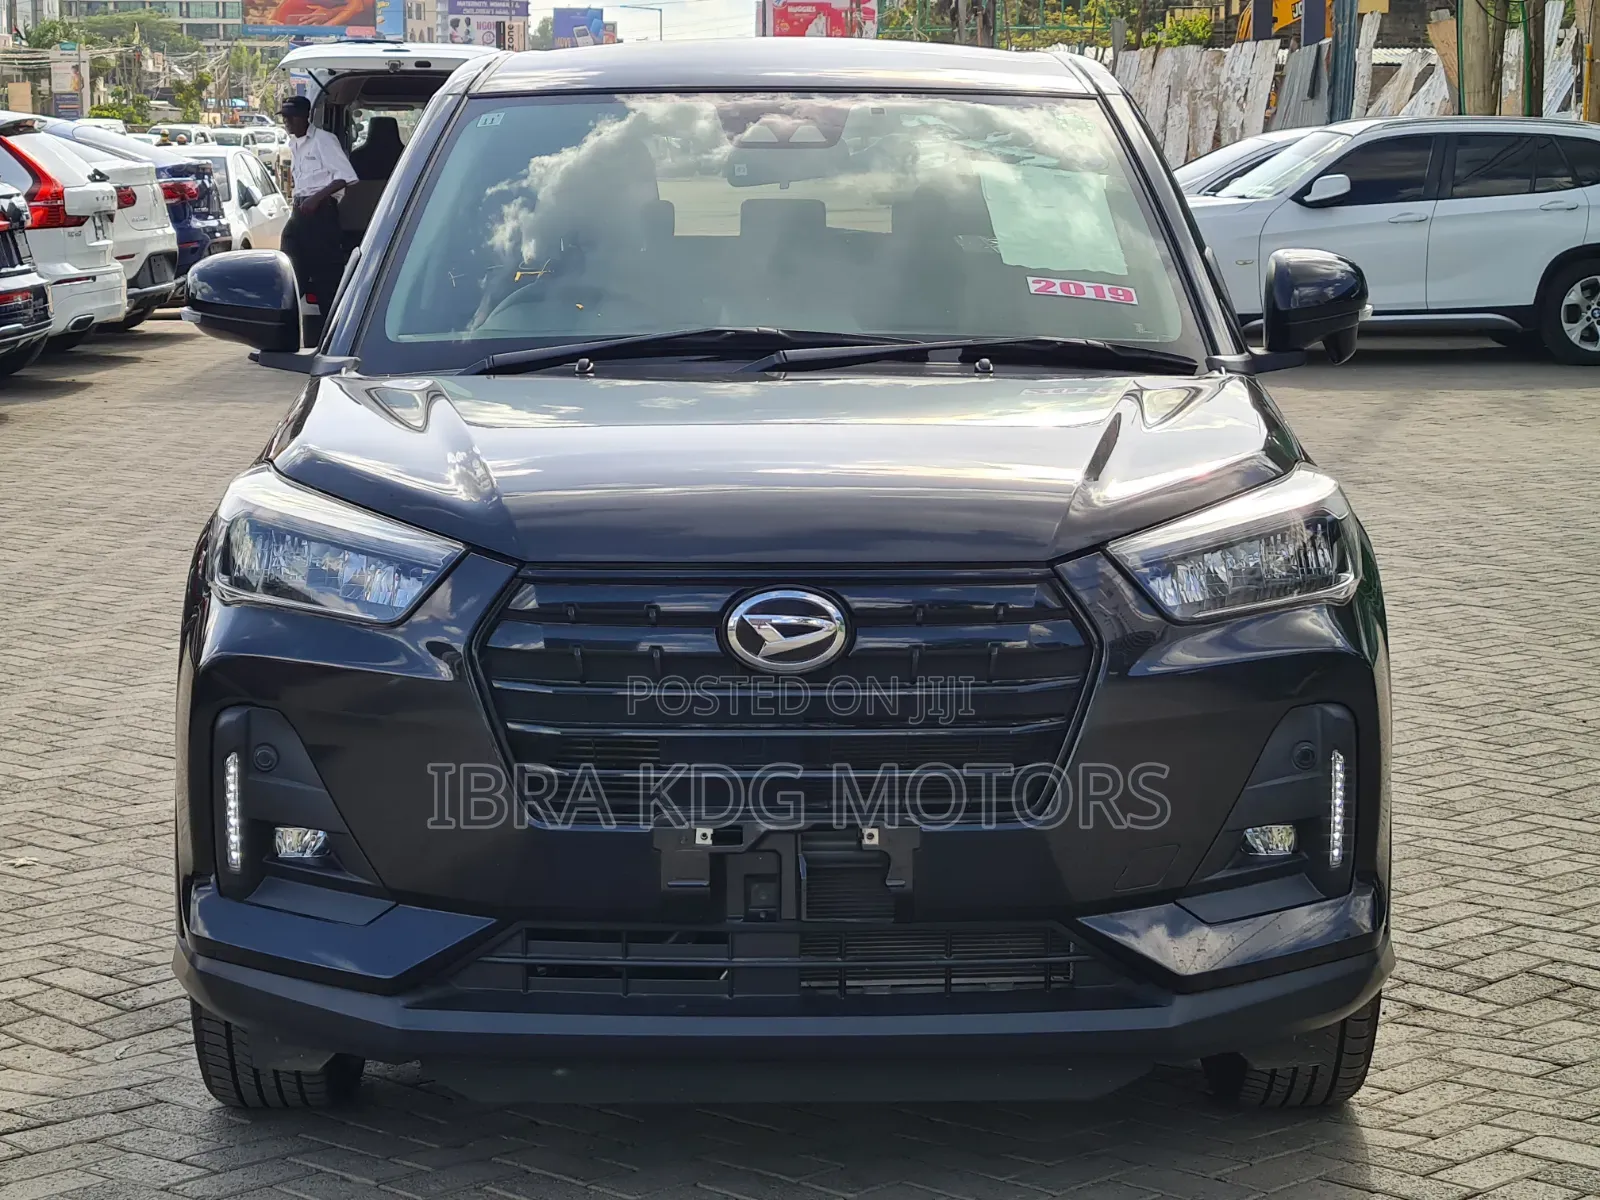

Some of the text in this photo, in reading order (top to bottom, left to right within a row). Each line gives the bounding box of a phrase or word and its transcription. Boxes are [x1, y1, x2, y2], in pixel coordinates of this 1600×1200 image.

[787, 5, 816, 13] HUGGIES
[1291, 1, 1304, 19] JC
[1031, 279, 1135, 303] 2019
